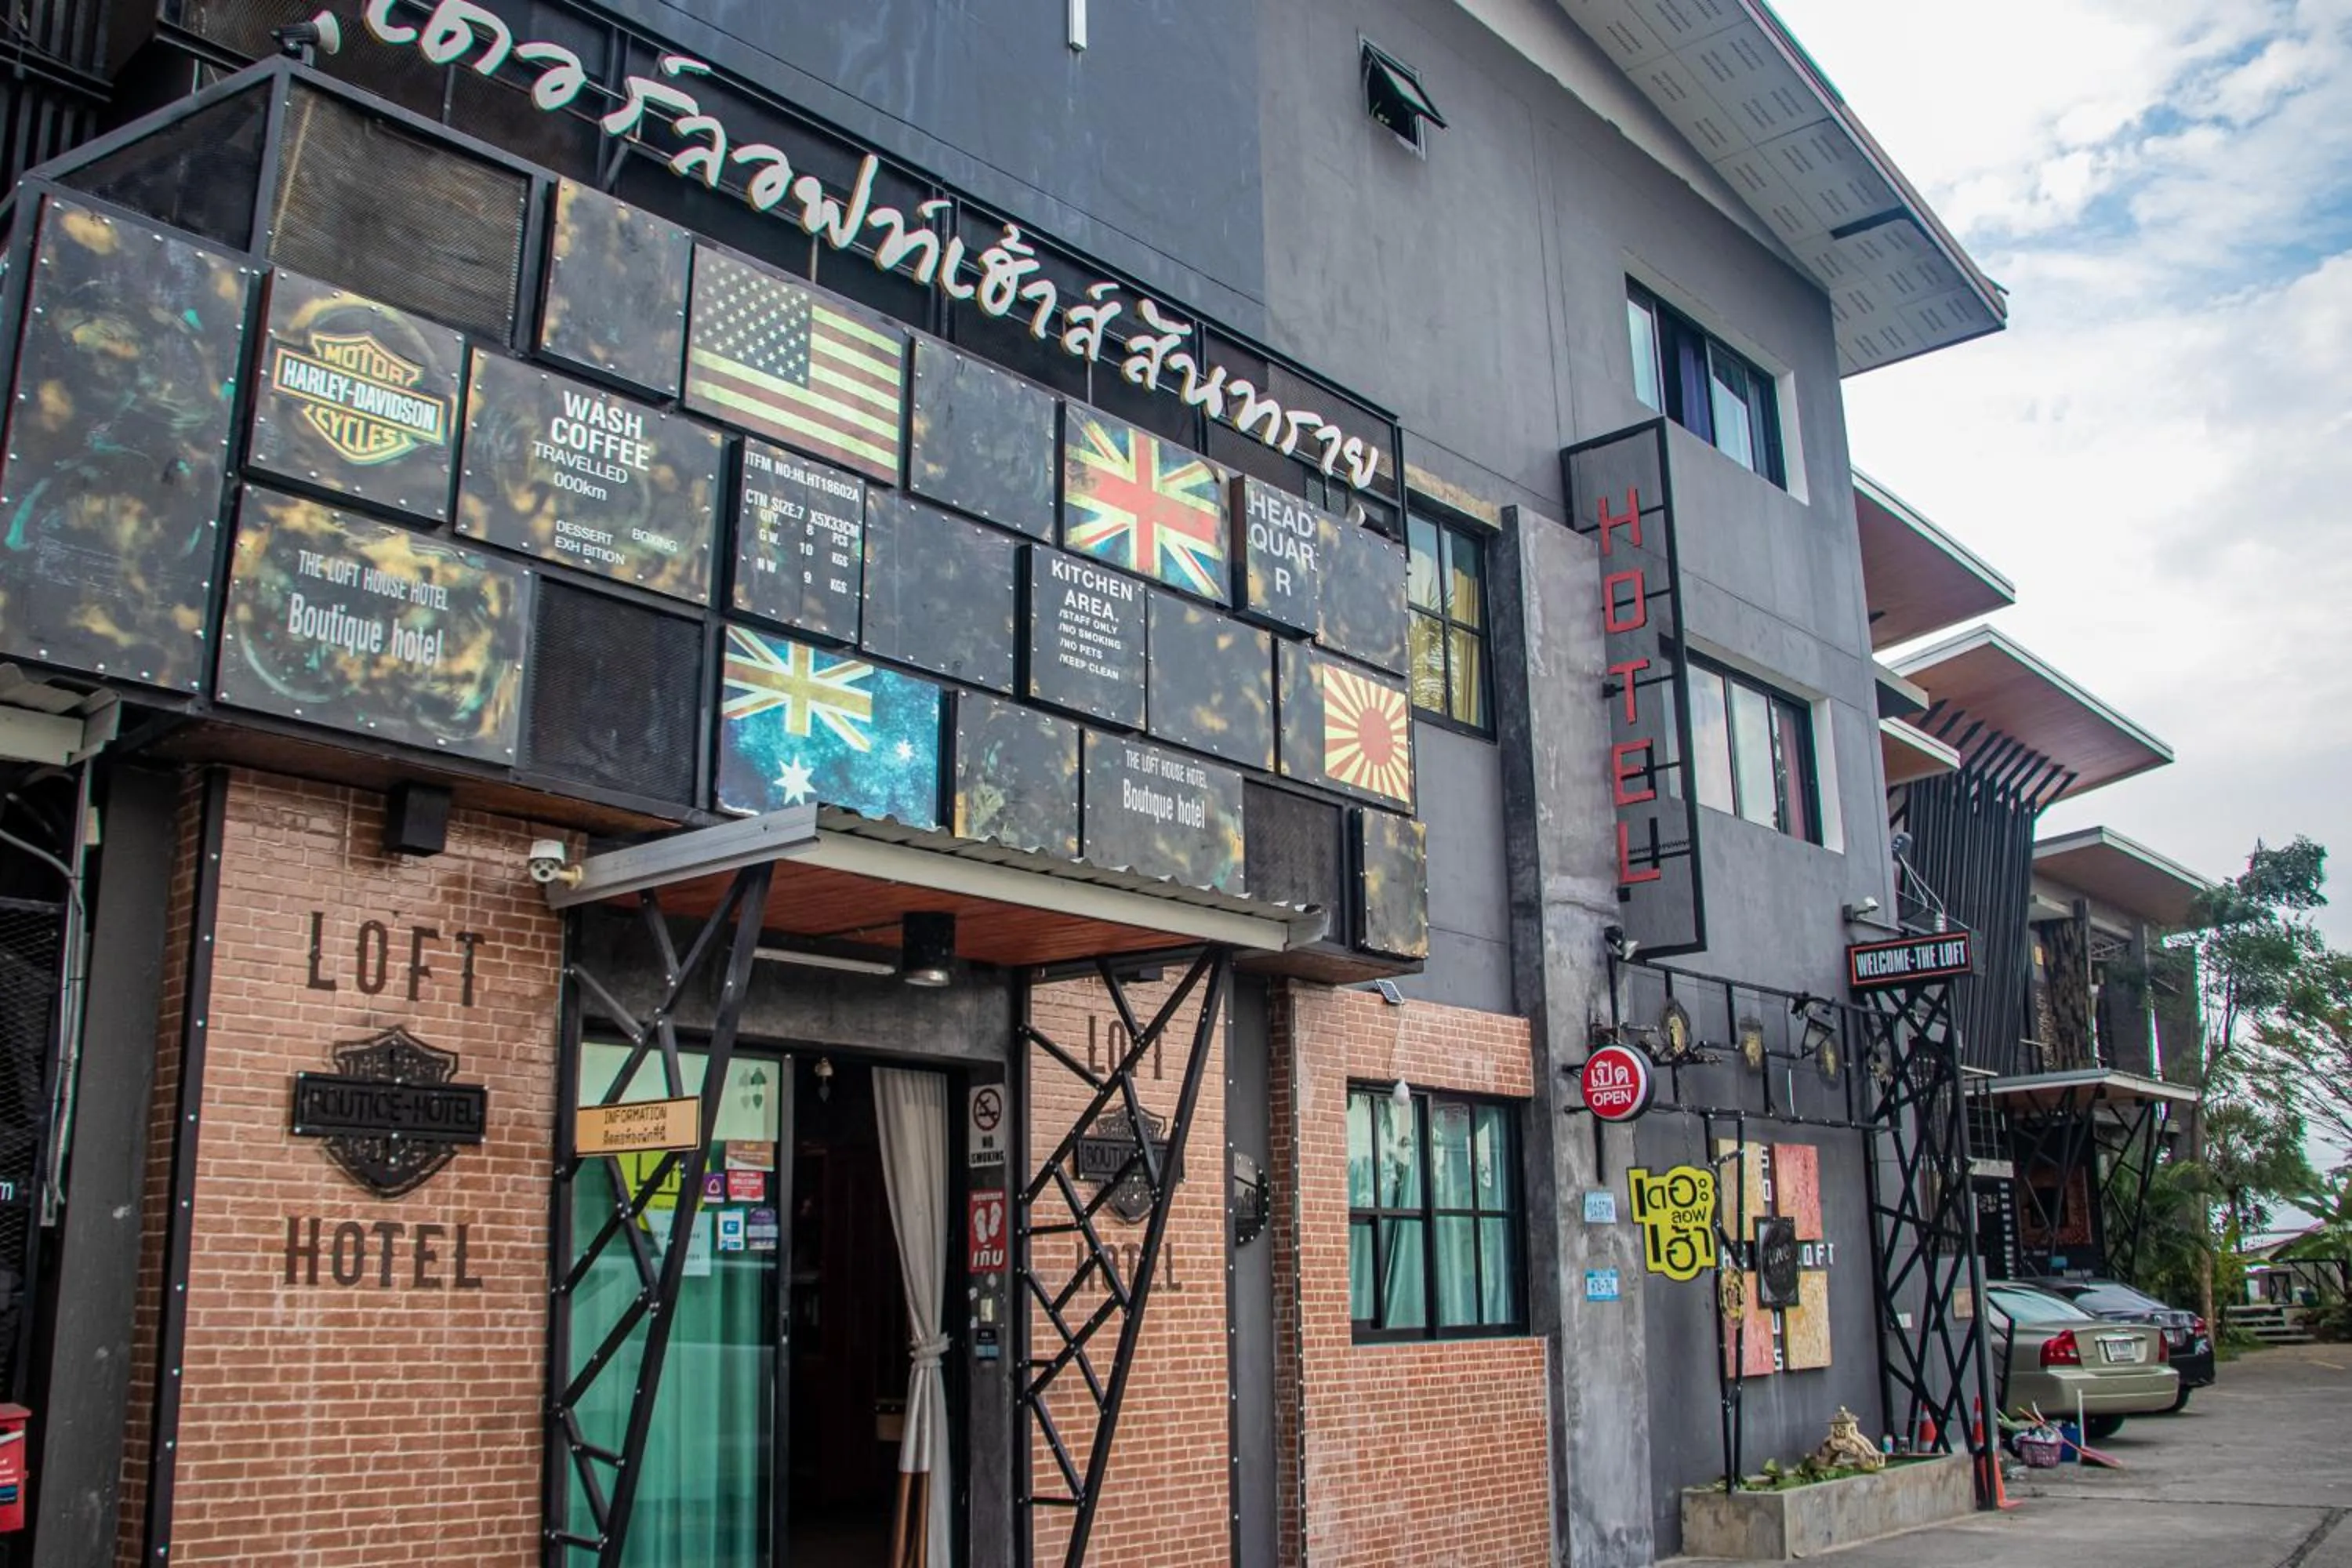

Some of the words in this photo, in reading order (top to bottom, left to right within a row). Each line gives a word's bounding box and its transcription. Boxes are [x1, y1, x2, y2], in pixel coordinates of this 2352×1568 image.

[324, 343, 405, 386] MOTOR
[283, 358, 437, 431] HARLEY-DAVIDSON
[315, 406, 398, 453] CYCLES
[564, 390, 644, 441] WASH
[532, 441, 628, 484] TRAVELLED
[551, 417, 651, 472] COFFEE
[746, 488, 768, 508] CTN
[1247, 490, 1313, 539] HEAD
[556, 520, 614, 546] DESSERT
[631, 528, 678, 553] BOXING
[799, 542, 814, 556] 10
[1249, 522, 1316, 571] QUAR
[298, 549, 324, 579] THE
[327, 557, 361, 588] LOFT
[363, 567, 407, 601] HOUSE
[410, 580, 449, 612] HOTEL
[803, 570, 812, 584] 9
[1051, 558, 1133, 602] KITCHEN
[1275, 566, 1292, 597] R
[1064, 589, 1120, 623] AREA.
[288, 592, 383, 658] Boutique
[391, 618, 444, 670] hotel
[1078, 628, 1121, 650] SMOKING
[1093, 619, 1118, 635] ONLY
[1080, 644, 1103, 659] PETS
[1088, 662, 1120, 681] CLEAN
[1597, 486, 1661, 887] HOTEL
[1125, 749, 1140, 770] THE
[1141, 753, 1160, 775] LOFT
[1161, 760, 1185, 783] HOUSE
[1186, 766, 1208, 789] HOTEL
[1123, 777, 1174, 824] Boutique
[1178, 793, 1205, 829] hotel
[307, 910, 486, 1007] LOFT
[1939, 941, 1965, 967] LOFT
[1591, 1060, 1630, 1087] เปิด
[1592, 1089, 1632, 1106] OPEN
[971, 1149, 1004, 1164] SMOKING
[982, 1134, 994, 1149] NO
[284, 1216, 484, 1289] HOTEL
